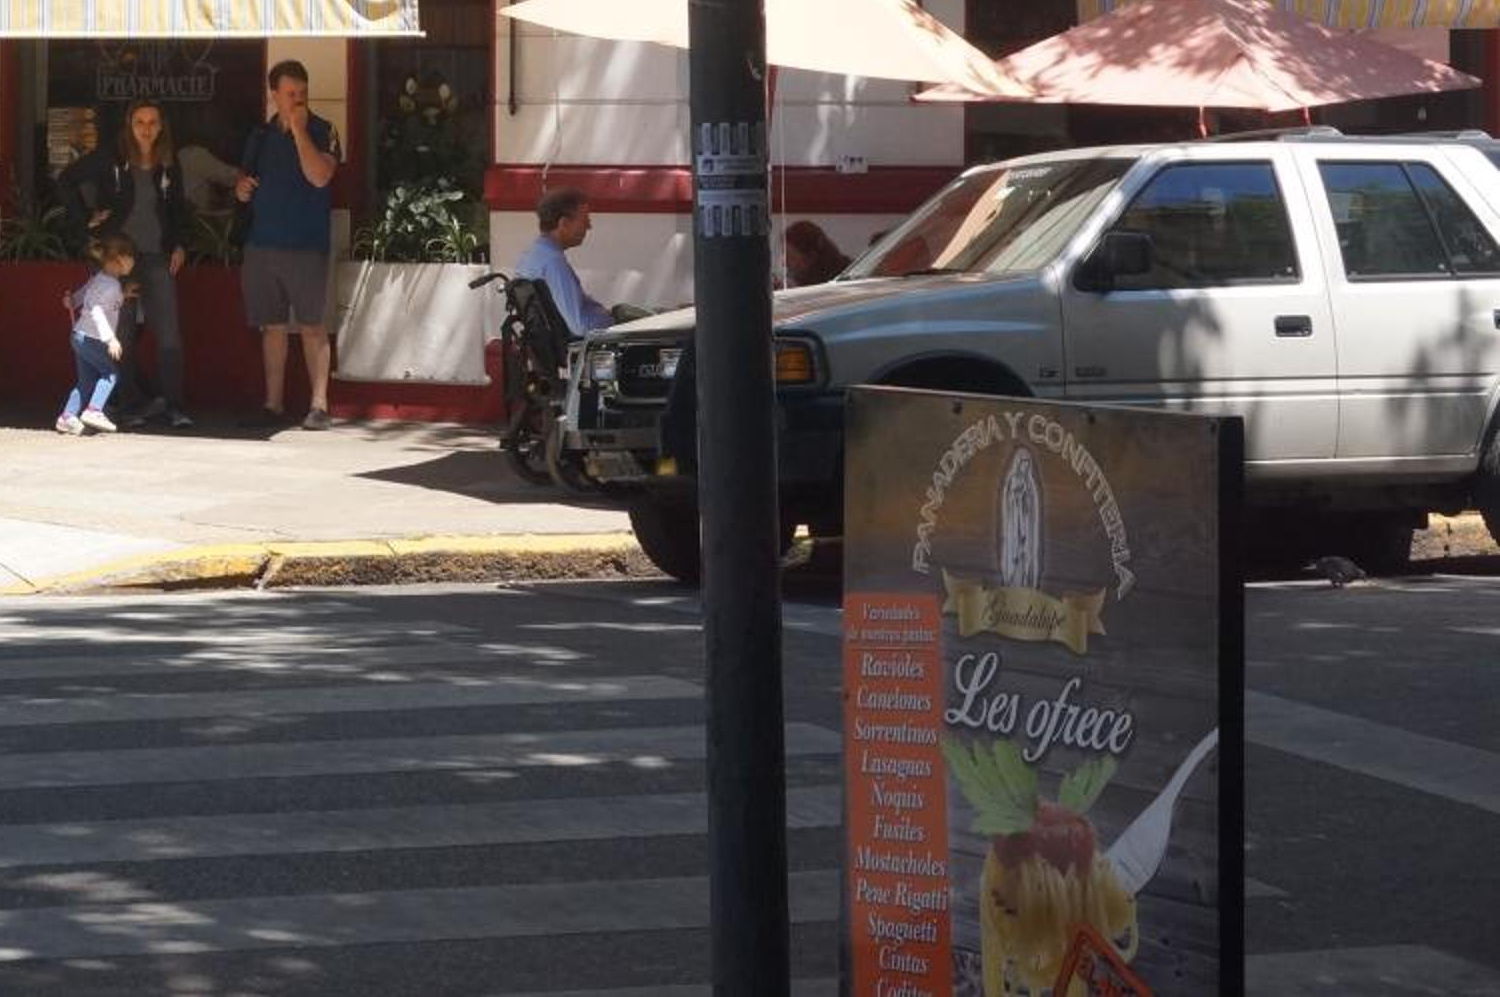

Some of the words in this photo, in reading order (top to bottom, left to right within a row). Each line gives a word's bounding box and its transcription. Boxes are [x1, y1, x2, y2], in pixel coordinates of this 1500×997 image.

[102, 74, 208, 95] PHARMACIE
[1003, 411, 1025, 439] Y
[861, 653, 925, 679] Ravioles
[857, 685, 932, 711] Canelones
[944, 653, 1019, 732] Les
[1023, 678, 1132, 761] ofrece
[854, 717, 938, 745] Sorrentinos
[861, 750, 932, 779] Lasagnas
[856, 845, 947, 876] Mostacholes
